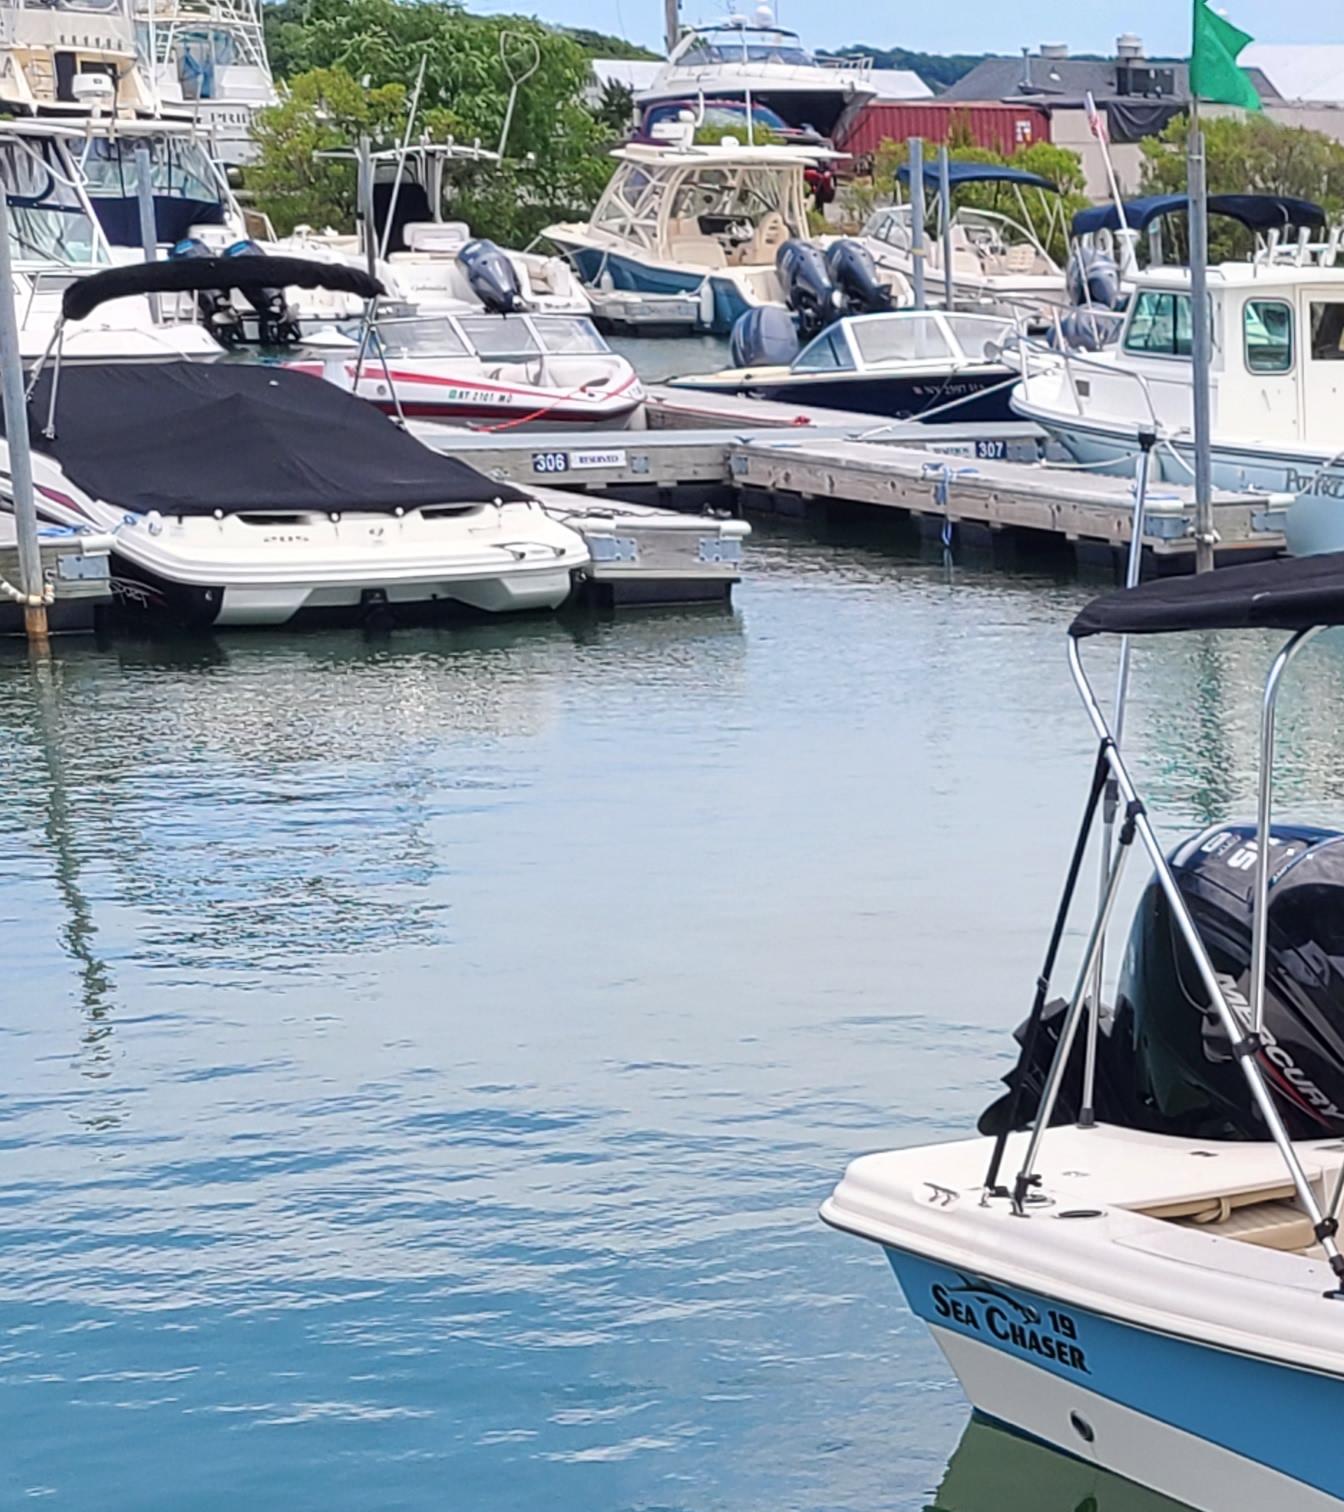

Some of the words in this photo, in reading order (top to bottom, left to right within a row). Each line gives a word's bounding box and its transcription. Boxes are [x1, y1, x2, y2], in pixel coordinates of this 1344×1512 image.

[978, 441, 1003, 458] 307
[535, 453, 566, 472] 306
[930, 1283, 981, 1331] SEA
[984, 1304, 1093, 1376] CHASER
[1047, 1309, 1078, 1341] 19
